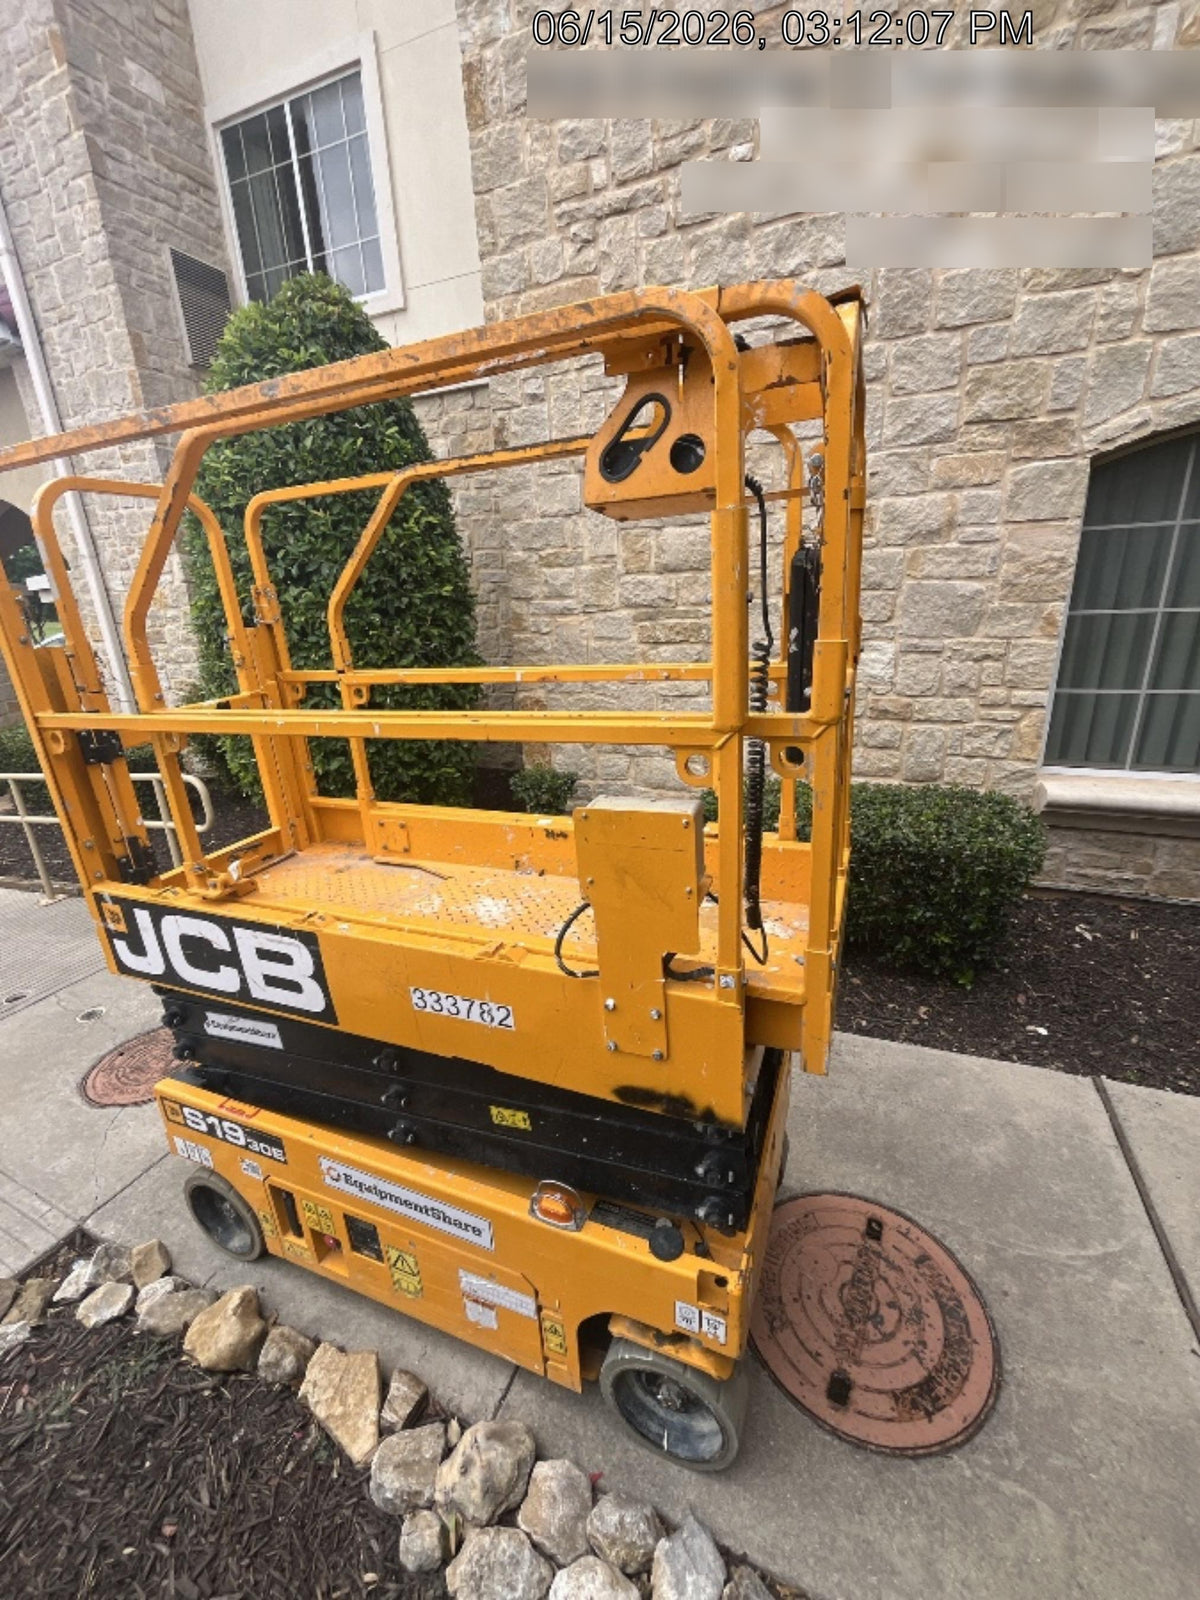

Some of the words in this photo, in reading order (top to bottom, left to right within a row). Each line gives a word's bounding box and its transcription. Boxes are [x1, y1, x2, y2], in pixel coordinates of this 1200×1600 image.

[112, 907, 327, 1013] JCB
[412, 987, 513, 1028] 333782
[342, 1173, 483, 1237] EquipmentShare
